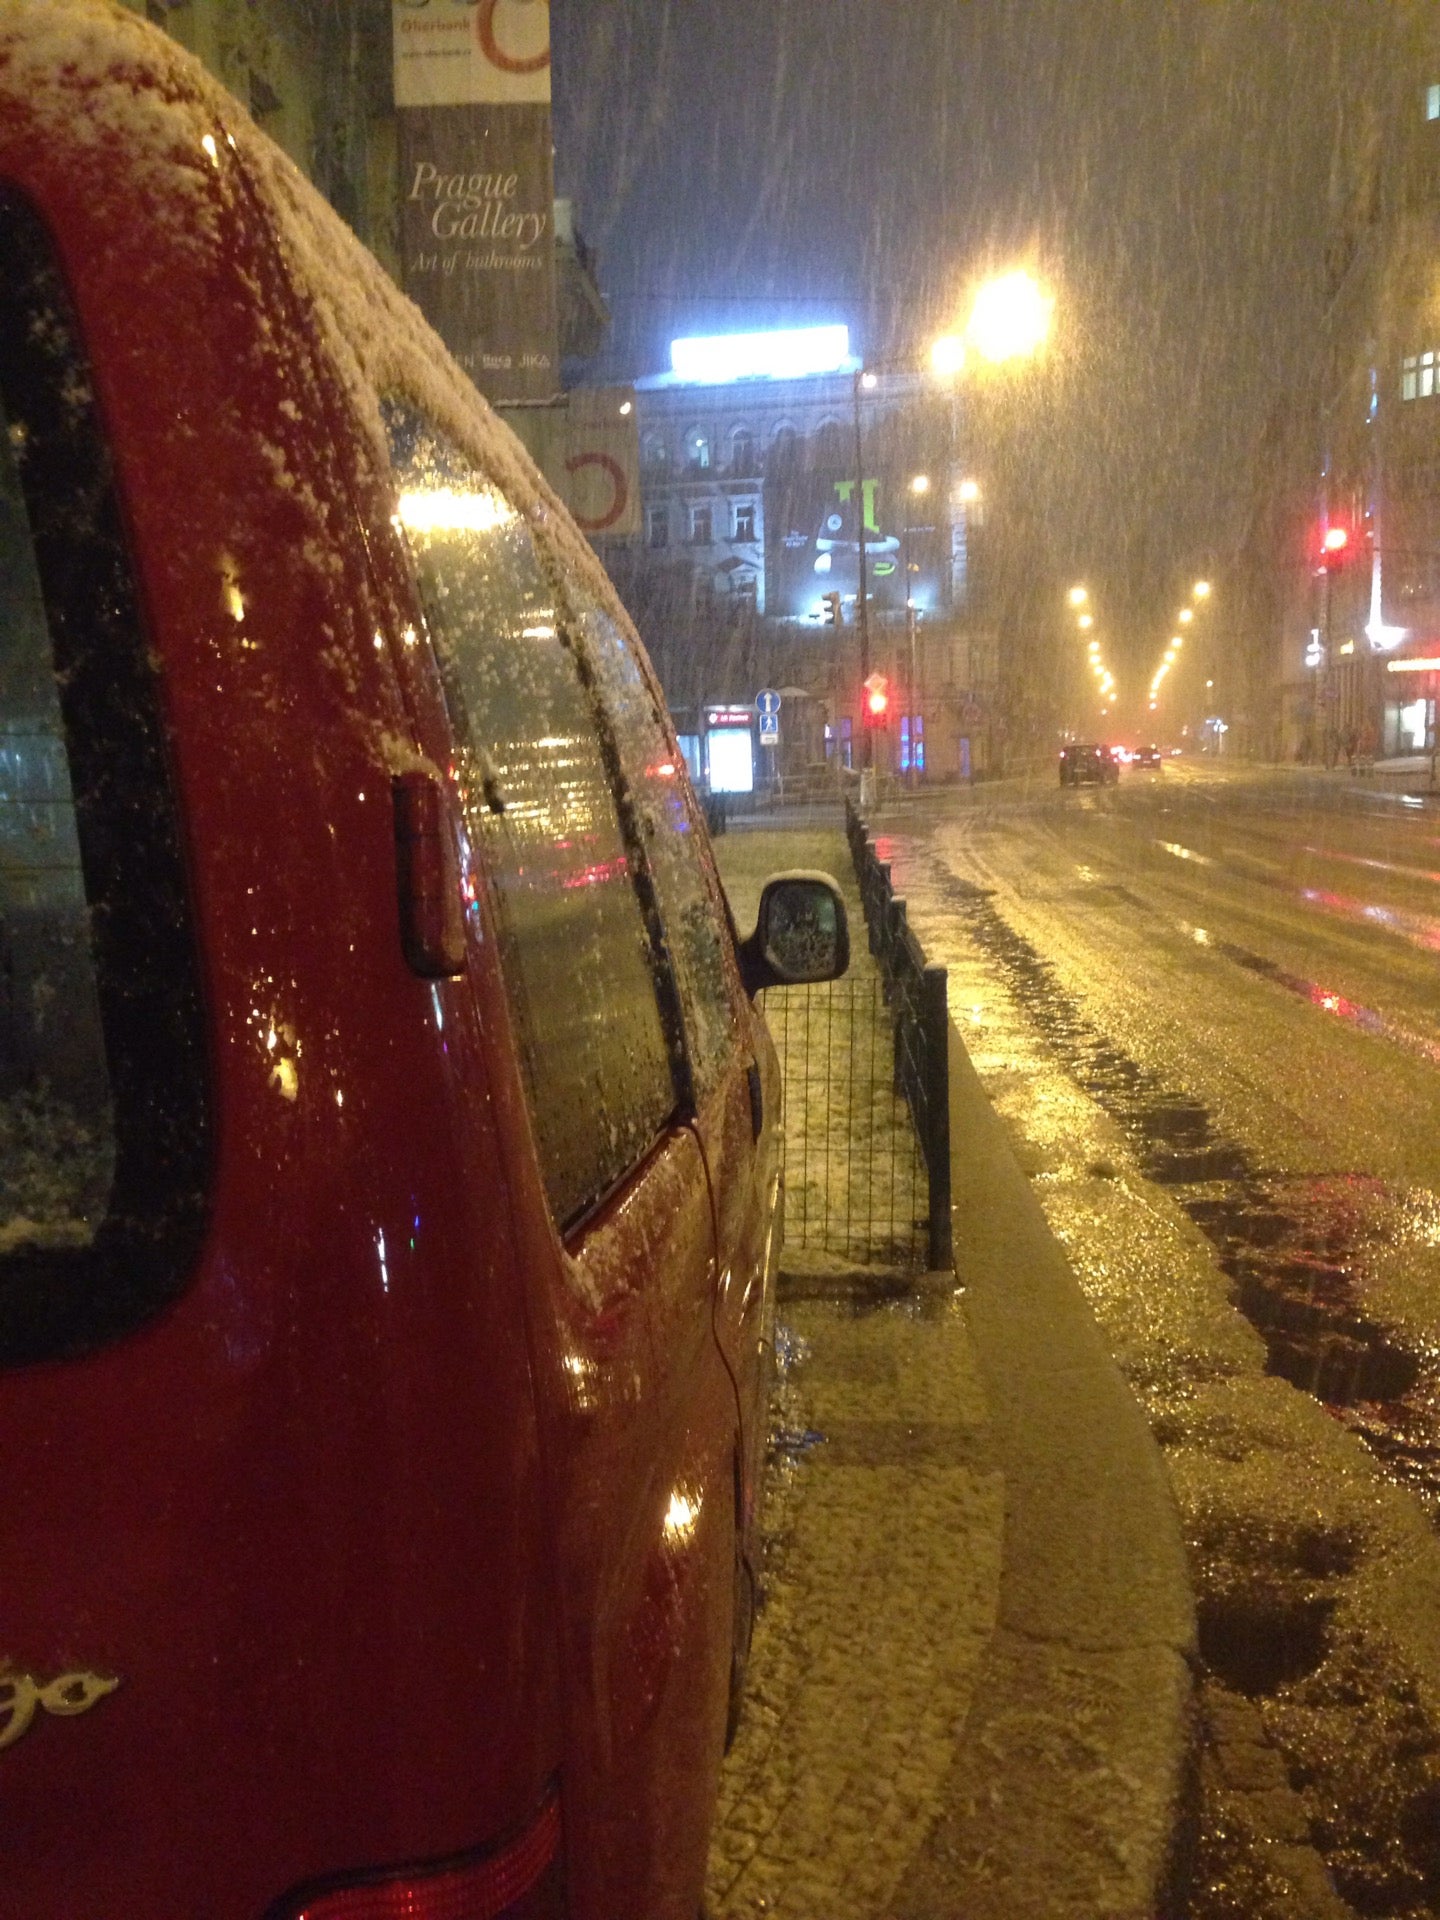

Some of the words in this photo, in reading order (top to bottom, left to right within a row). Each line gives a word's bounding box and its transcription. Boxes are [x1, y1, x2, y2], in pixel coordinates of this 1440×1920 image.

[408, 161, 519, 210] Prague
[431, 201, 547, 250] Gallery
[410, 252, 437, 272] Art
[442, 250, 459, 277] of
